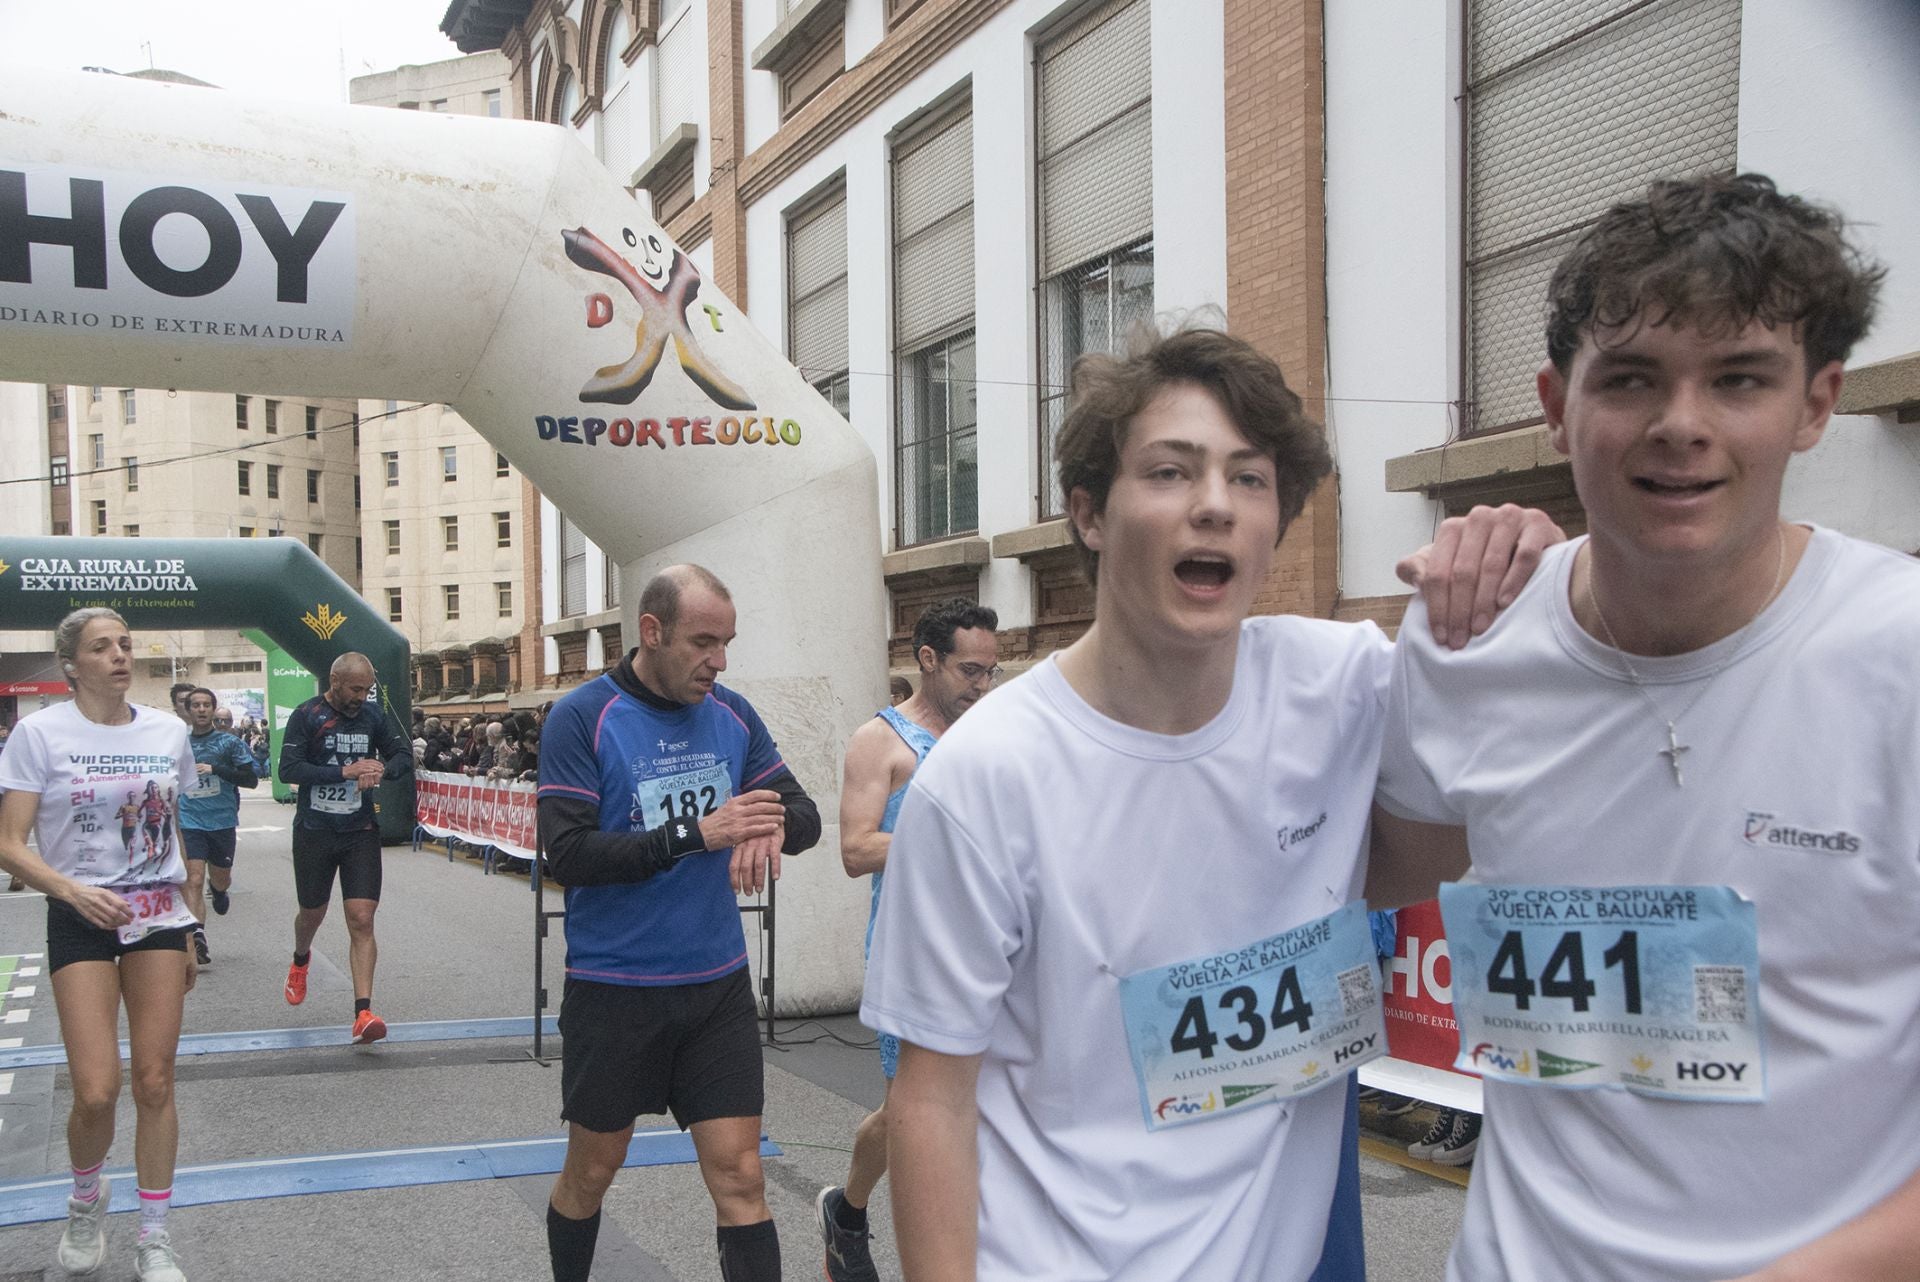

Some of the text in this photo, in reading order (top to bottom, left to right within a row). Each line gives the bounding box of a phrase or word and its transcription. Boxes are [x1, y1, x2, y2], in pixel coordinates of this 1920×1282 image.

[0, 170, 346, 304] HOY
[0, 306, 345, 343] DIARIO DE EXTREMADURA
[535, 414, 801, 450] DEPORTEOCIO
[20, 558, 185, 575] CAJA RURAL DE
[20, 575, 199, 591] EXTREMADURA
[127, 597, 196, 609] Extremadura
[69, 755, 96, 764] VIII
[681, 752, 716, 762] SOLIDARIA
[72, 773, 142, 785] de Almendral
[86, 765, 170, 775] POPULAR
[71, 788, 95, 806] 24
[318, 787, 347, 802] 522
[660, 779, 686, 791] VUELTA
[659, 785, 718, 821] 182
[1766, 825, 1862, 853] attendis
[1524, 889, 1594, 902] CROSS
[1599, 889, 1697, 904] POPULAR
[1488, 901, 1699, 921] VUELTA AL BALUARTE
[1201, 946, 1259, 971] CROSS
[1261, 918, 1332, 951] POPULAR
[1169, 929, 1332, 990] VUELTA AL BALUARTE
[1383, 936, 1454, 1005] HO
[1486, 929, 1643, 1015] 441
[1170, 965, 1314, 1060] 434
[1384, 1007, 1460, 1031] DIARIO DE EXTR
[1482, 1015, 1731, 1042] RODRIGO TARRUELLA GRAGERA
[1172, 1018, 1361, 1082] ALFONSO ALBARRAN CRUZATE
[1333, 1033, 1378, 1064] HOY
[1676, 1061, 1749, 1082] HOY
